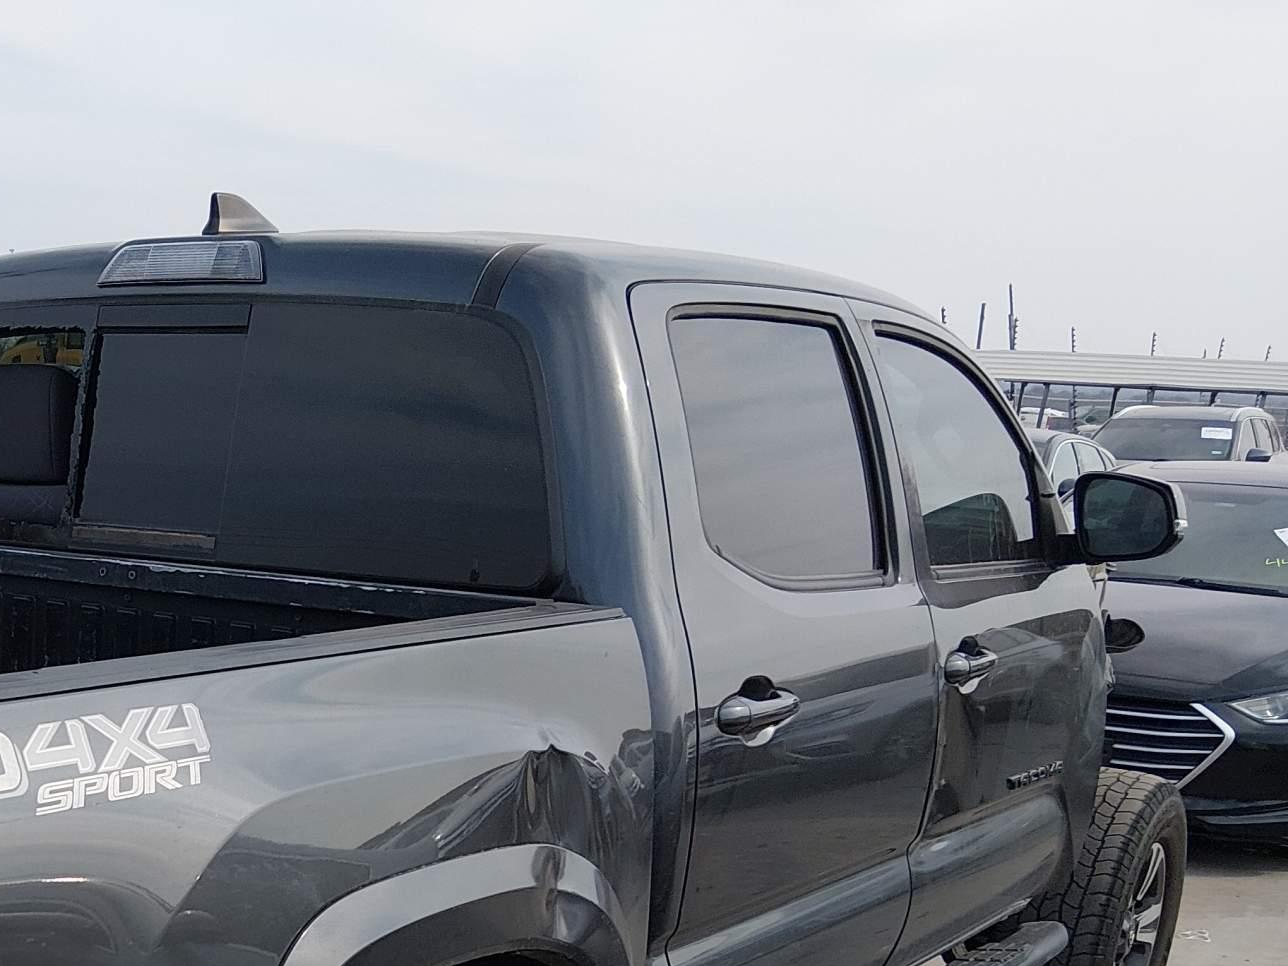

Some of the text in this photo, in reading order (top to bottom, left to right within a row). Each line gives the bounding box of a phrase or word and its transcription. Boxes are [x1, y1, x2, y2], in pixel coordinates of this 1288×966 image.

[22, 702, 211, 774] 4X4
[34, 754, 211, 816] SPORT
[1006, 760, 1064, 790] TACOMA
